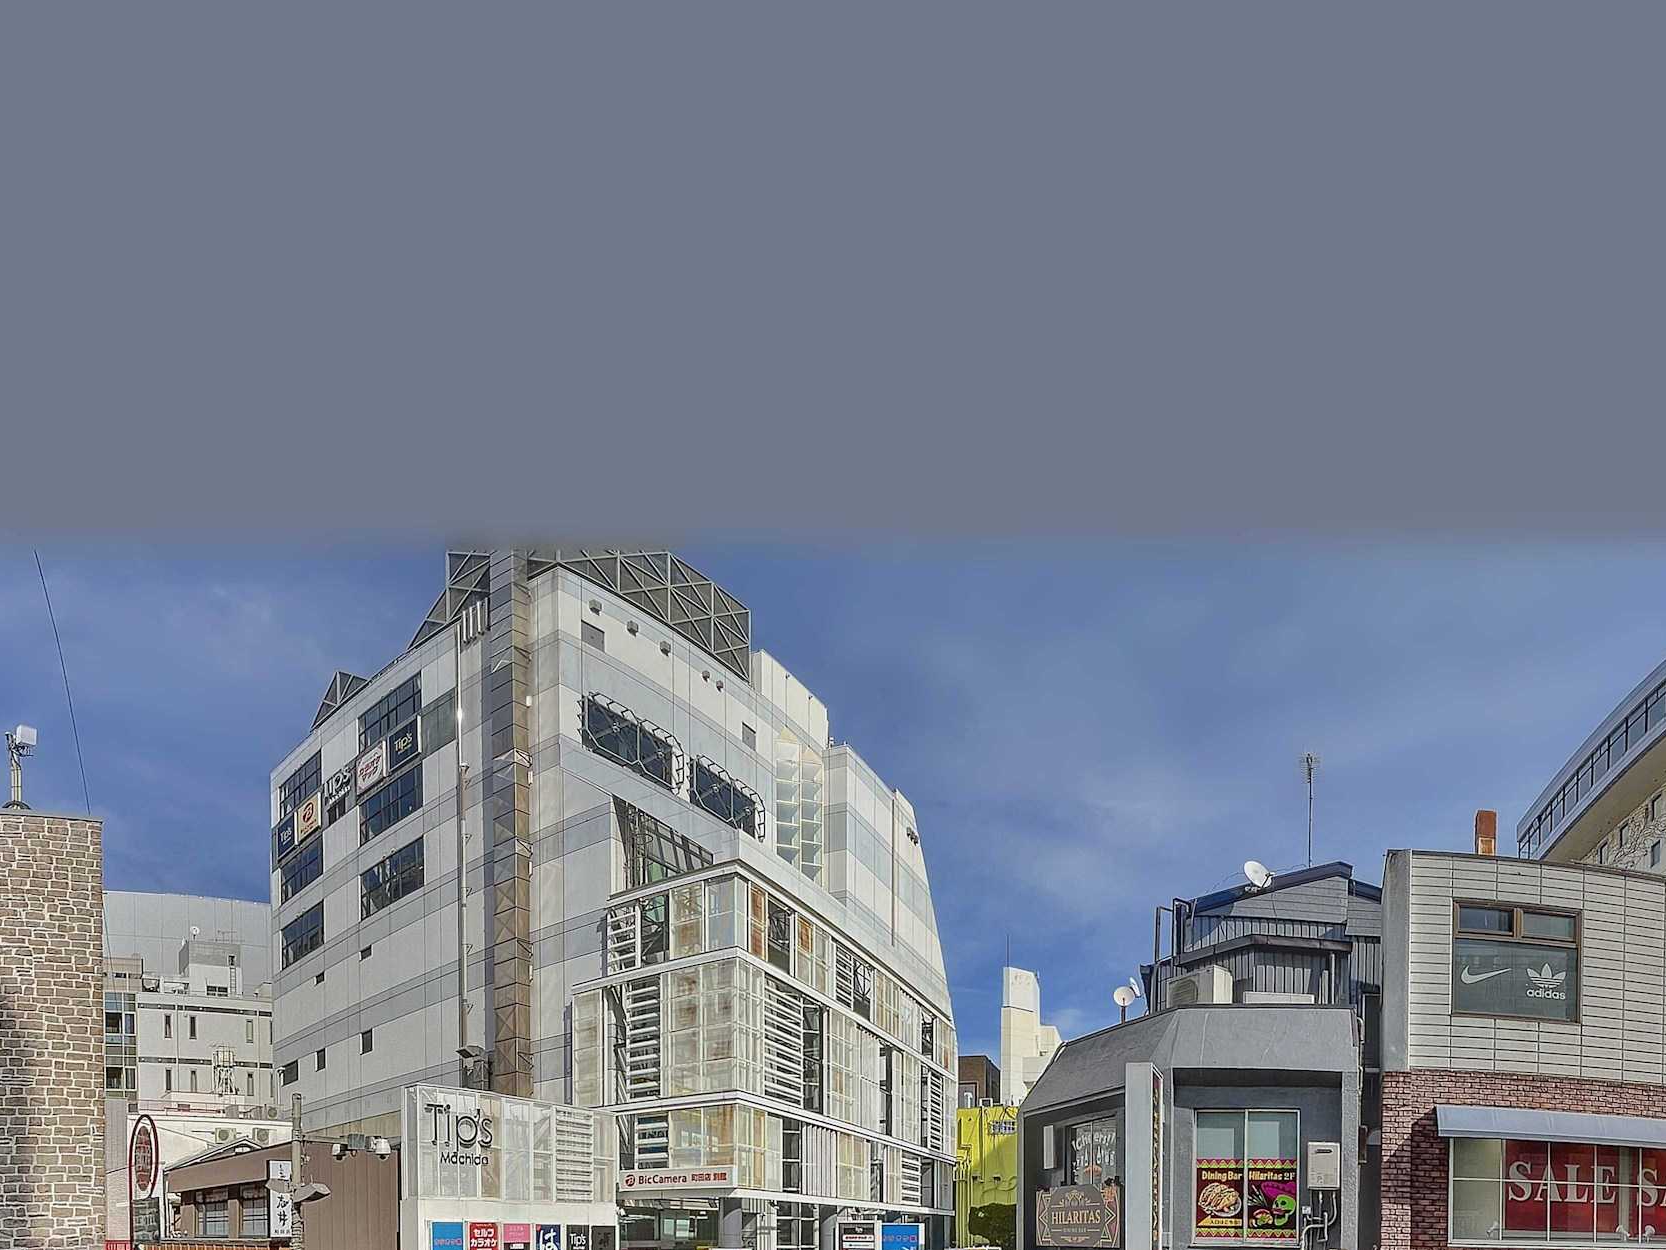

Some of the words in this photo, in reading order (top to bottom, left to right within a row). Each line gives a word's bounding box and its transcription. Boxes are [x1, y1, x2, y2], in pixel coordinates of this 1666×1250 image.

[1526, 988, 1566, 1000] adidas
[425, 1103, 493, 1152] Tip's
[440, 1151, 489, 1165] Machida
[638, 1174, 687, 1184] BicCamera
[1202, 1171, 1226, 1181] Dining
[1228, 1171, 1242, 1180] Bar
[1249, 1171, 1283, 1180] Hilaritas
[1508, 1161, 1617, 1205] SALE
[1051, 1210, 1101, 1225] HILARITAS
[470, 1238, 497, 1247] カラオケ
[569, 1233, 586, 1247] Tip's
